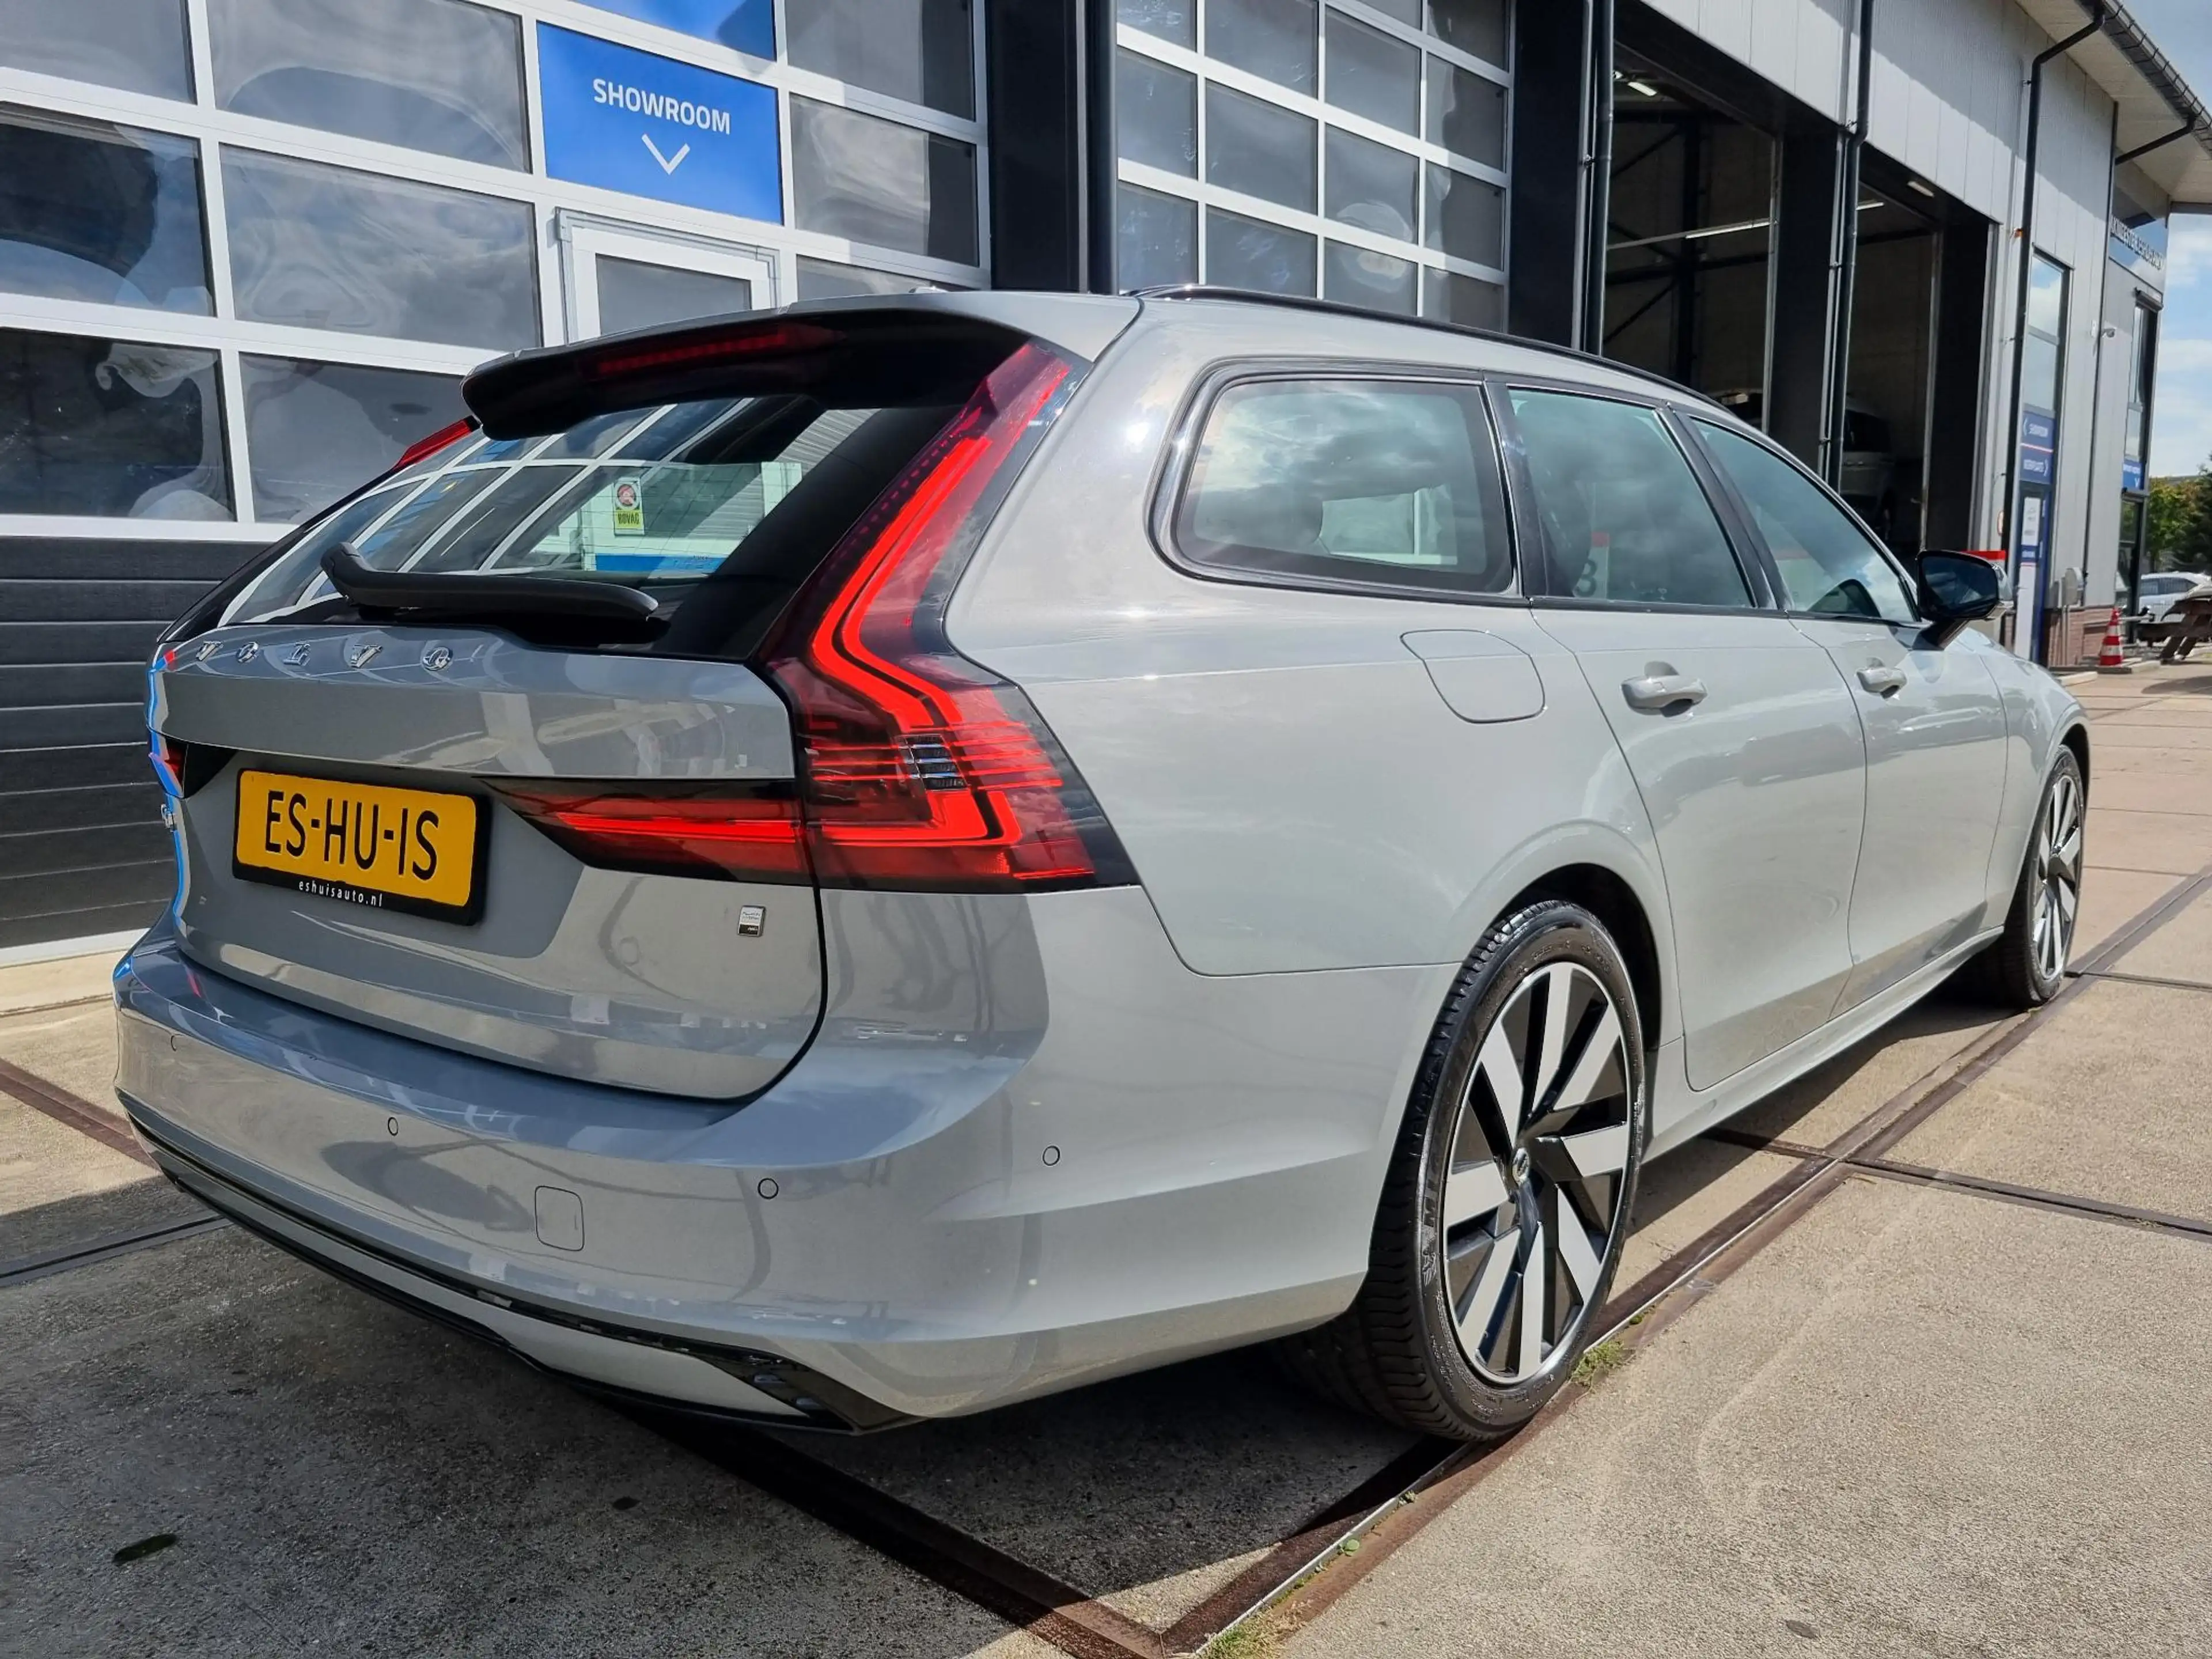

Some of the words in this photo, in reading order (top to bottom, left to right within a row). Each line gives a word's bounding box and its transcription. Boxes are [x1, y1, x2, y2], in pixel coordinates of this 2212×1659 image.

[593, 78, 730, 135] SHOWROOM
[195, 640, 454, 671] VOLVO
[265, 790, 440, 881] ES-HU-IS
[299, 880, 382, 907] eshuisauto.nl
